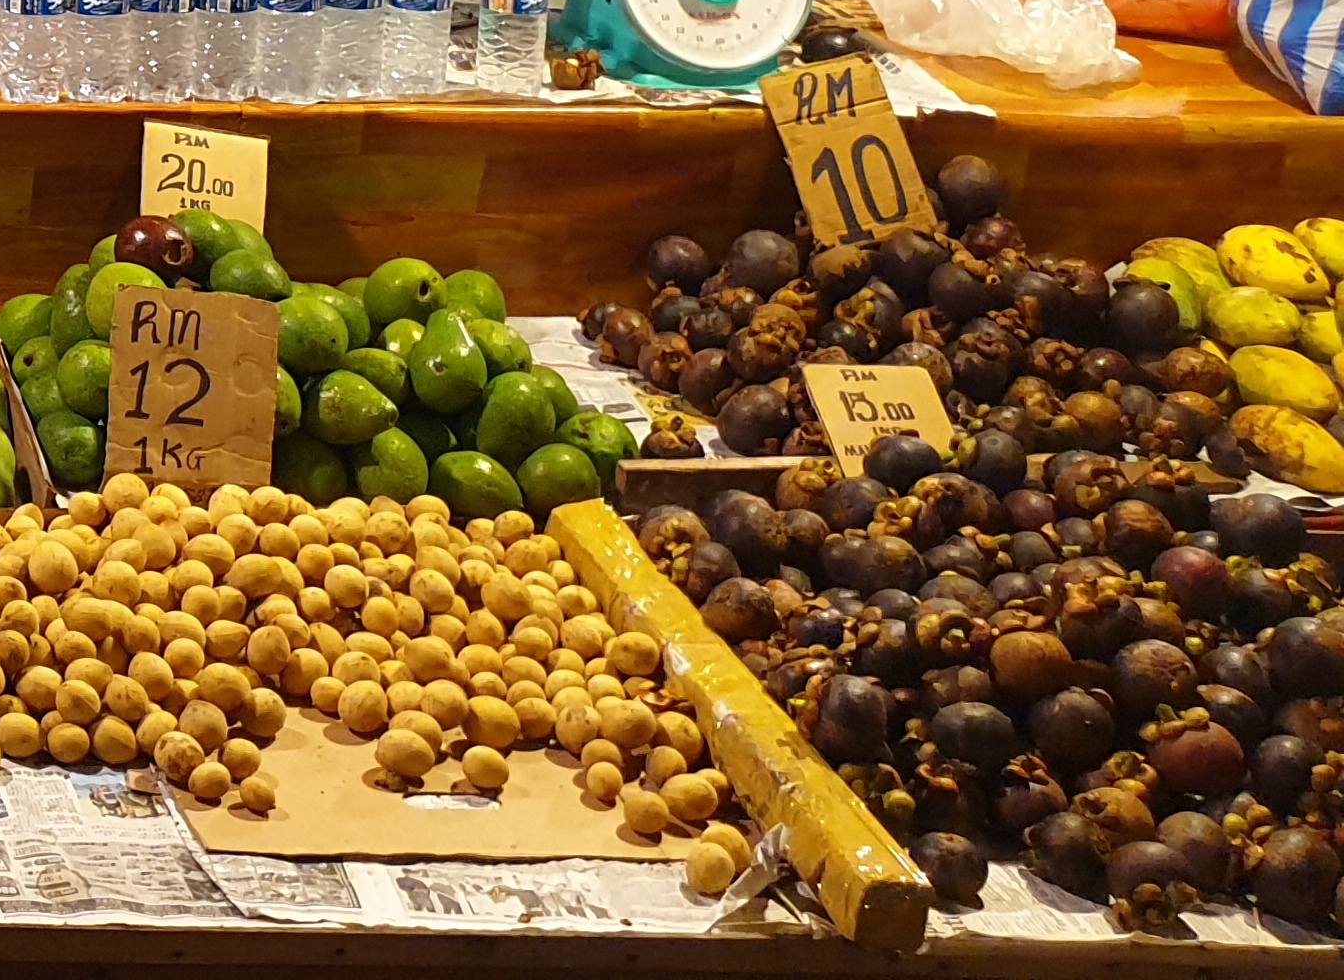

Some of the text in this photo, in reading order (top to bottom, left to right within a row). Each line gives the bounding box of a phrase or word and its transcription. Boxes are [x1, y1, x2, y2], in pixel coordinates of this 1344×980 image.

[793, 66, 857, 126] RM
[174, 131, 210, 149] RM
[156, 153, 234, 198] 20.00
[811, 134, 909, 245] 10
[124, 358, 211, 427] 12
[839, 368, 878, 382] RM
[838, 390, 916, 423] 15.00
